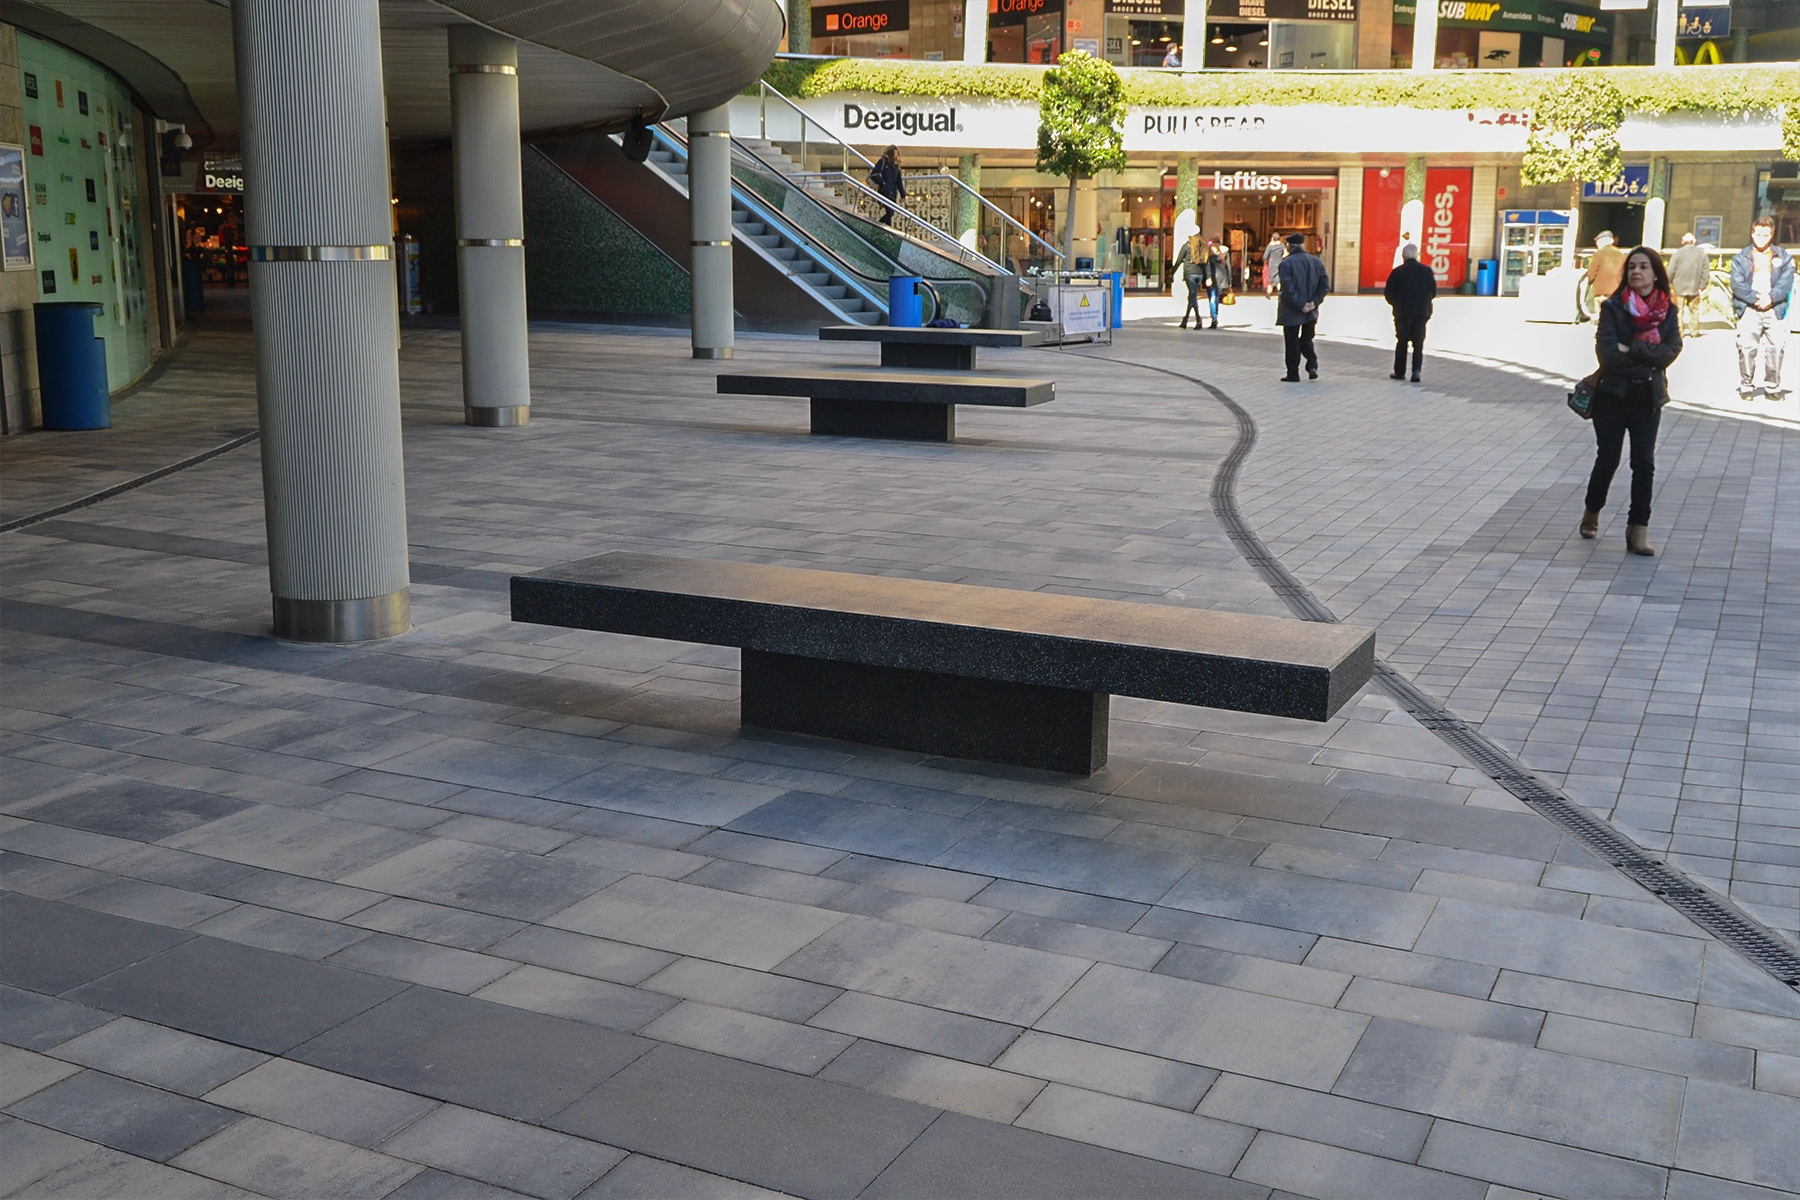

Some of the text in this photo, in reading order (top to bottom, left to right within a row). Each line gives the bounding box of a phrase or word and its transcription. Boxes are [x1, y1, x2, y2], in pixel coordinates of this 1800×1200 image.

[1239, 7, 1266, 17] DIESEL
[1308, 0, 1354, 10] DIESEL
[1438, 1, 1500, 21] SUBWAY
[842, 12, 888, 31] Orange
[1560, 12, 1596, 33] SUBWAY
[843, 103, 956, 137] Desigual
